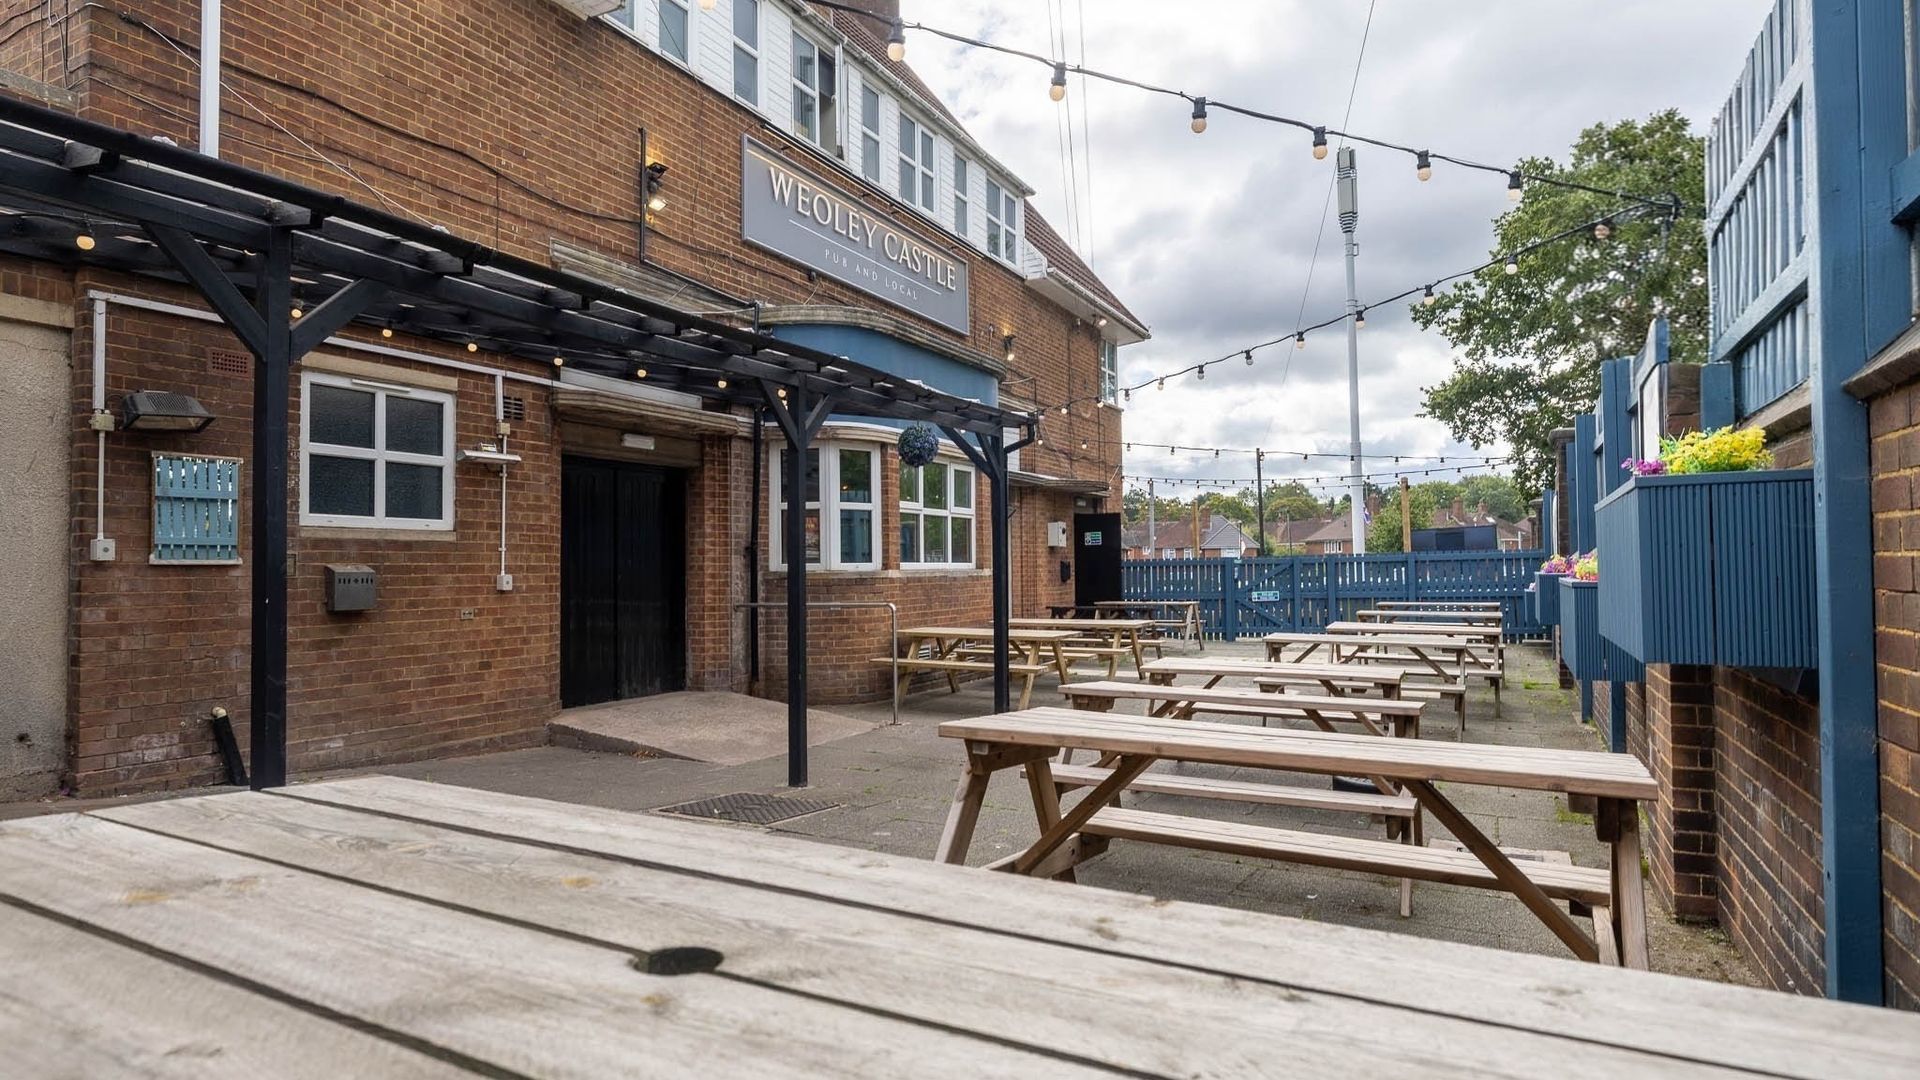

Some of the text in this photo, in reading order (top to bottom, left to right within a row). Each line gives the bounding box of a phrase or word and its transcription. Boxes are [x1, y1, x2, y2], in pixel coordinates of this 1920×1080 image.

[769, 166, 956, 291] WEOLEY CASTLE
[825, 249, 918, 300] PUB AND LOCAL
